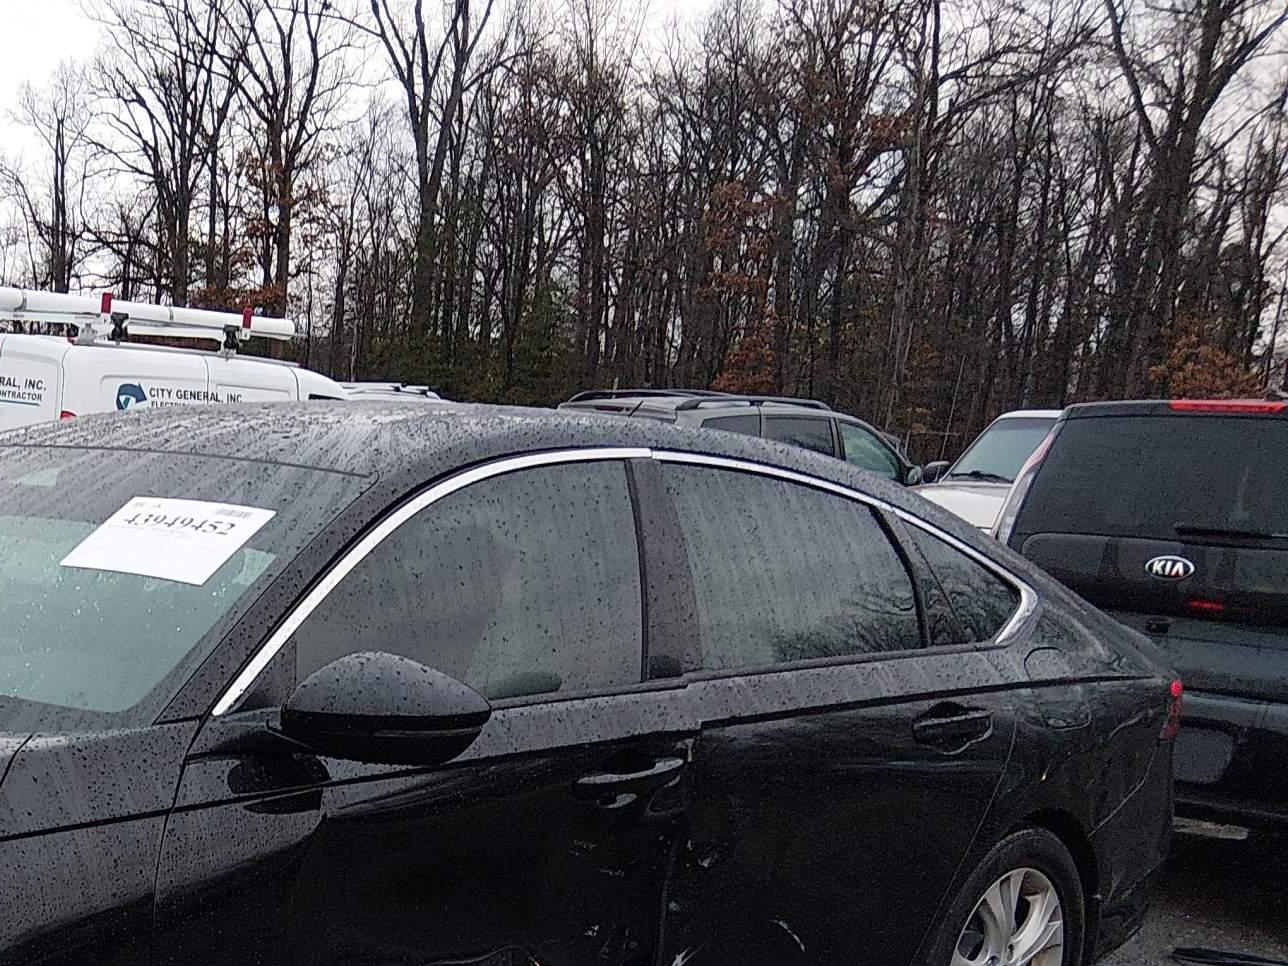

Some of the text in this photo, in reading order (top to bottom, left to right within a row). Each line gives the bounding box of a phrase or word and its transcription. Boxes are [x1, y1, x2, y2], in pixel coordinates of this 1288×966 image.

[24, 378, 47, 391] INC.
[149, 387, 173, 399] CITY
[124, 512, 236, 535] 43949452
[1152, 560, 1184, 576] KIA
